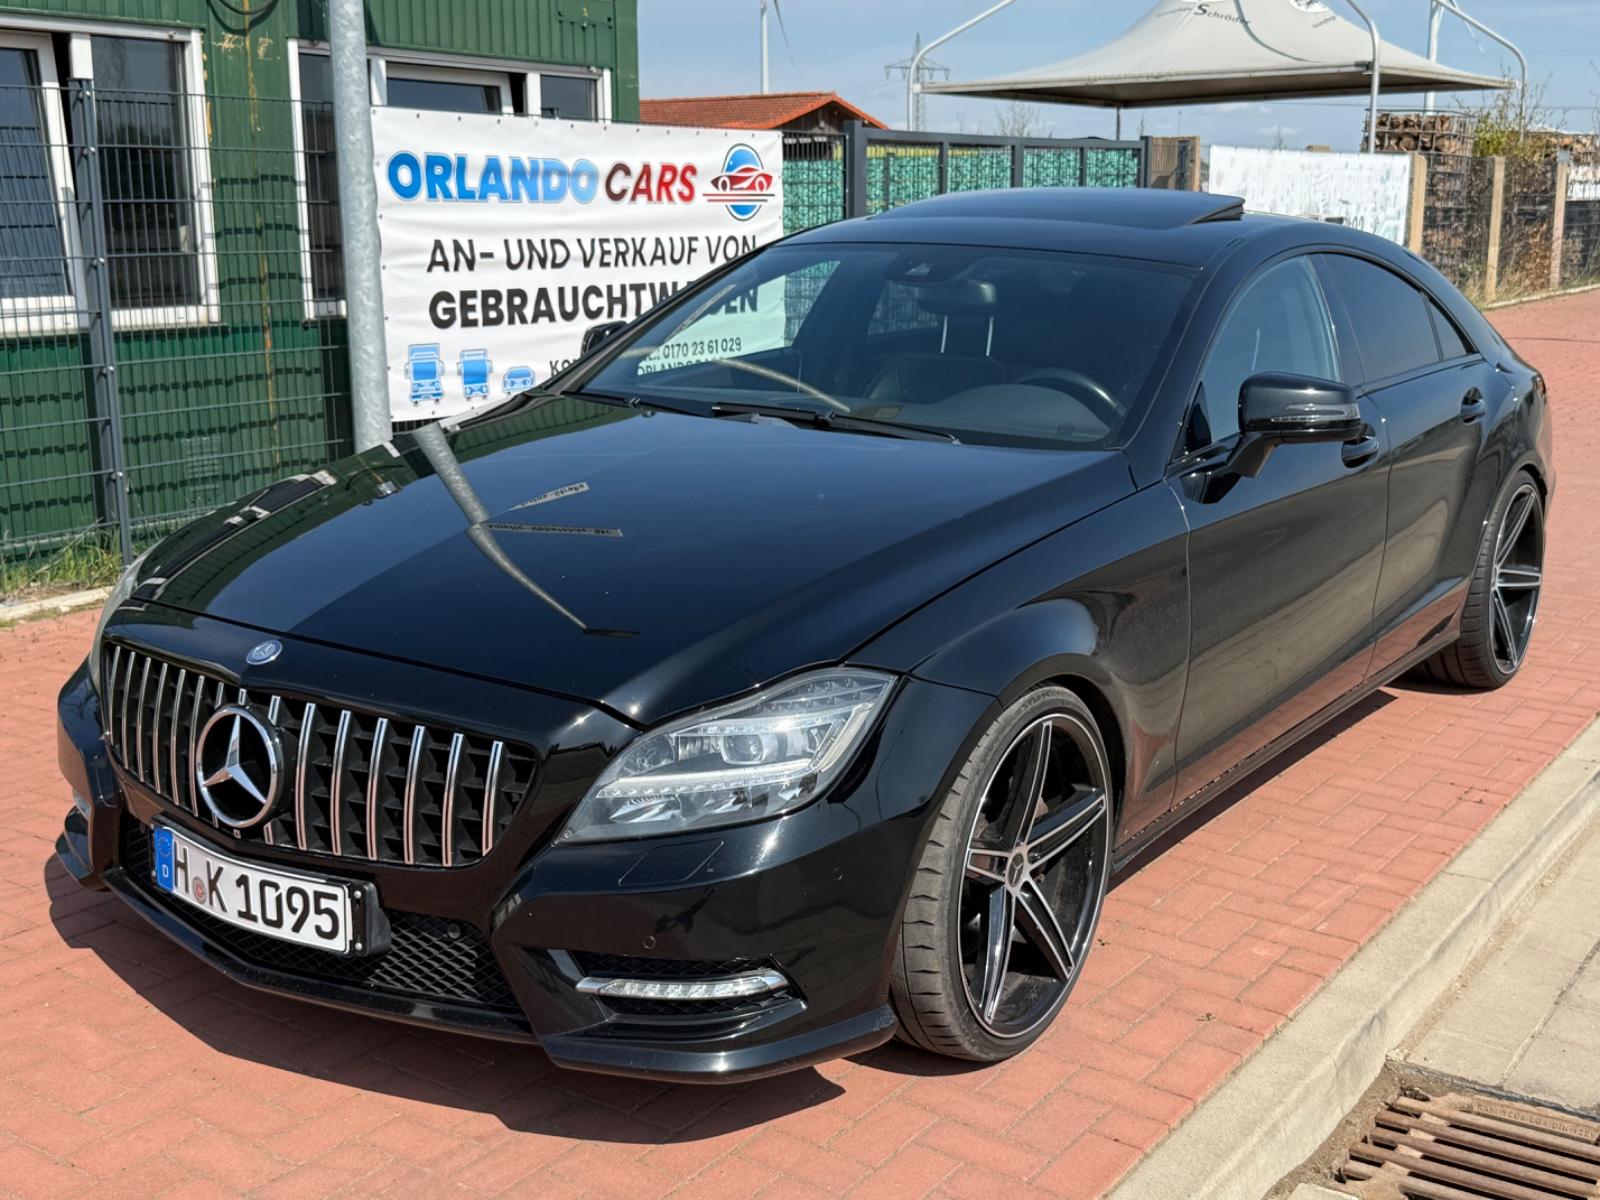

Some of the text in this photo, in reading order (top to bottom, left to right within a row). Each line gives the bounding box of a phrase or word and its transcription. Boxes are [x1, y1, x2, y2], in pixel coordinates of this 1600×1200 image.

[388, 150, 697, 205] ORLANDO CARS
[427, 234, 756, 272] AN- UND VERKAUF VON
[428, 281, 759, 330] GEBRAUCHTWEN
[663, 343, 689, 359] 0170
[691, 341, 705, 356] 23
[707, 340, 718, 354] 61
[721, 337, 742, 353] 029
[162, 863, 170, 879] D
